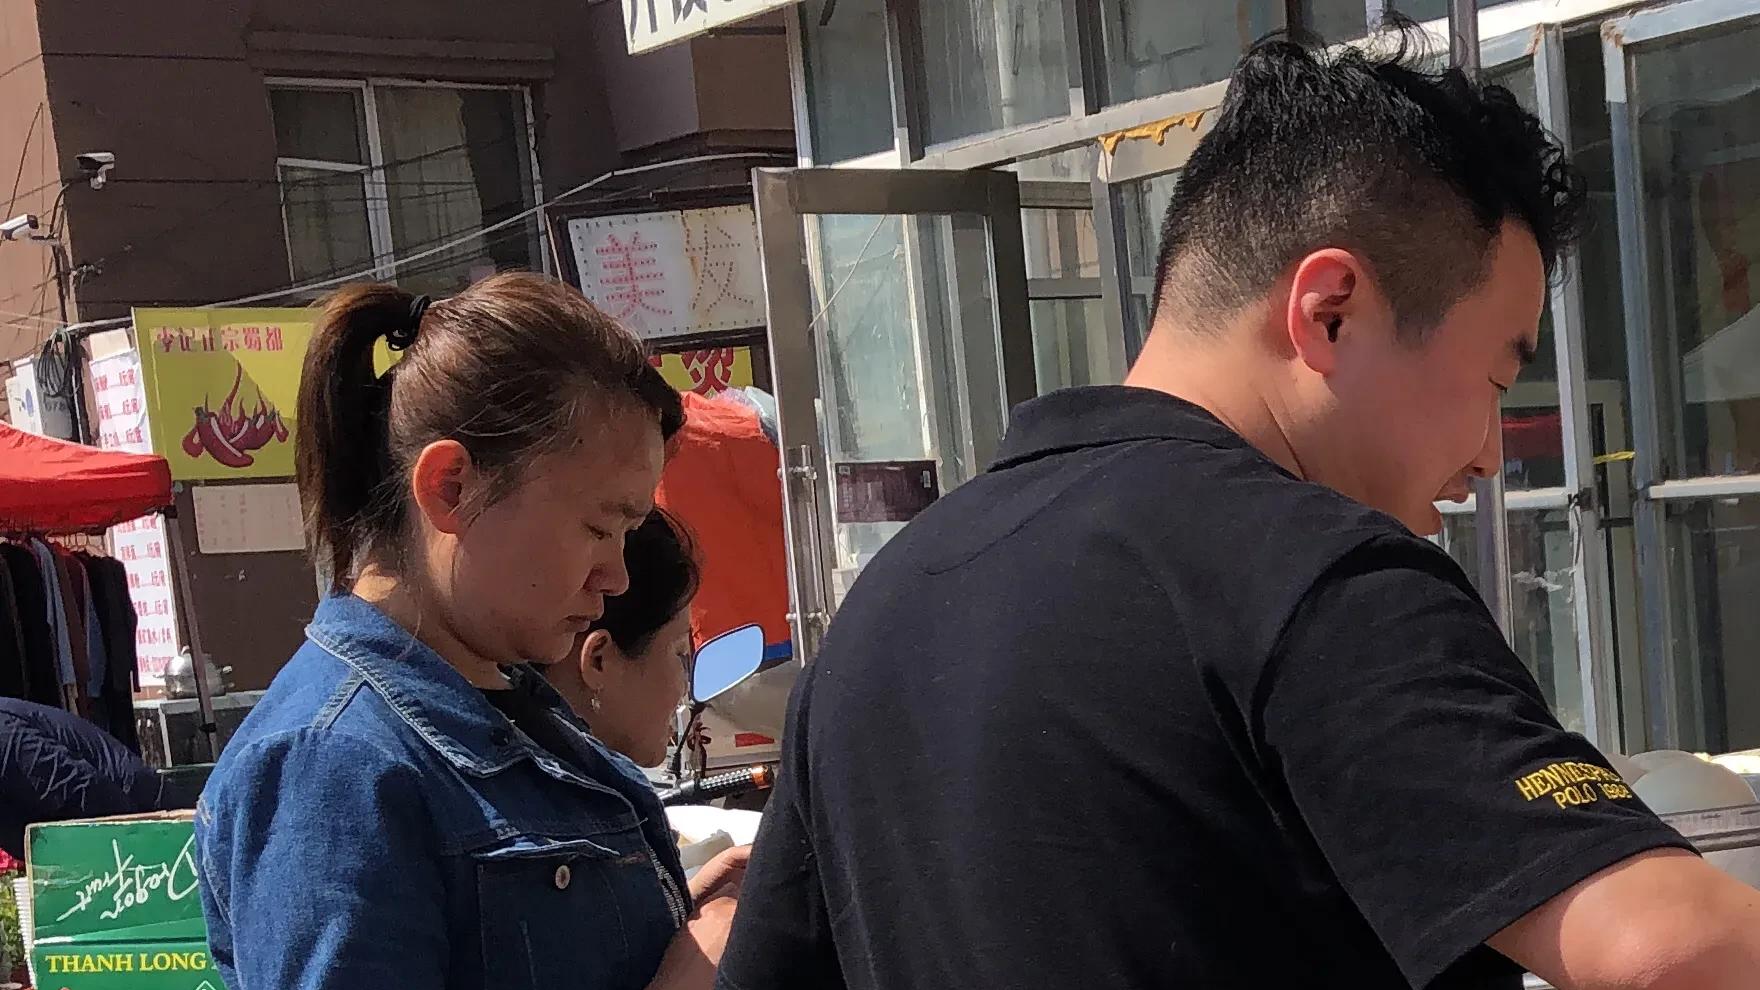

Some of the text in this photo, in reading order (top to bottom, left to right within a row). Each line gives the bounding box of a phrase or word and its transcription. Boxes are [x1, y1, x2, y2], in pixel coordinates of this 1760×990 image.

[1552, 783, 1598, 809] POLO
[45, 953, 133, 973] THANH
[139, 952, 207, 971] LONG
